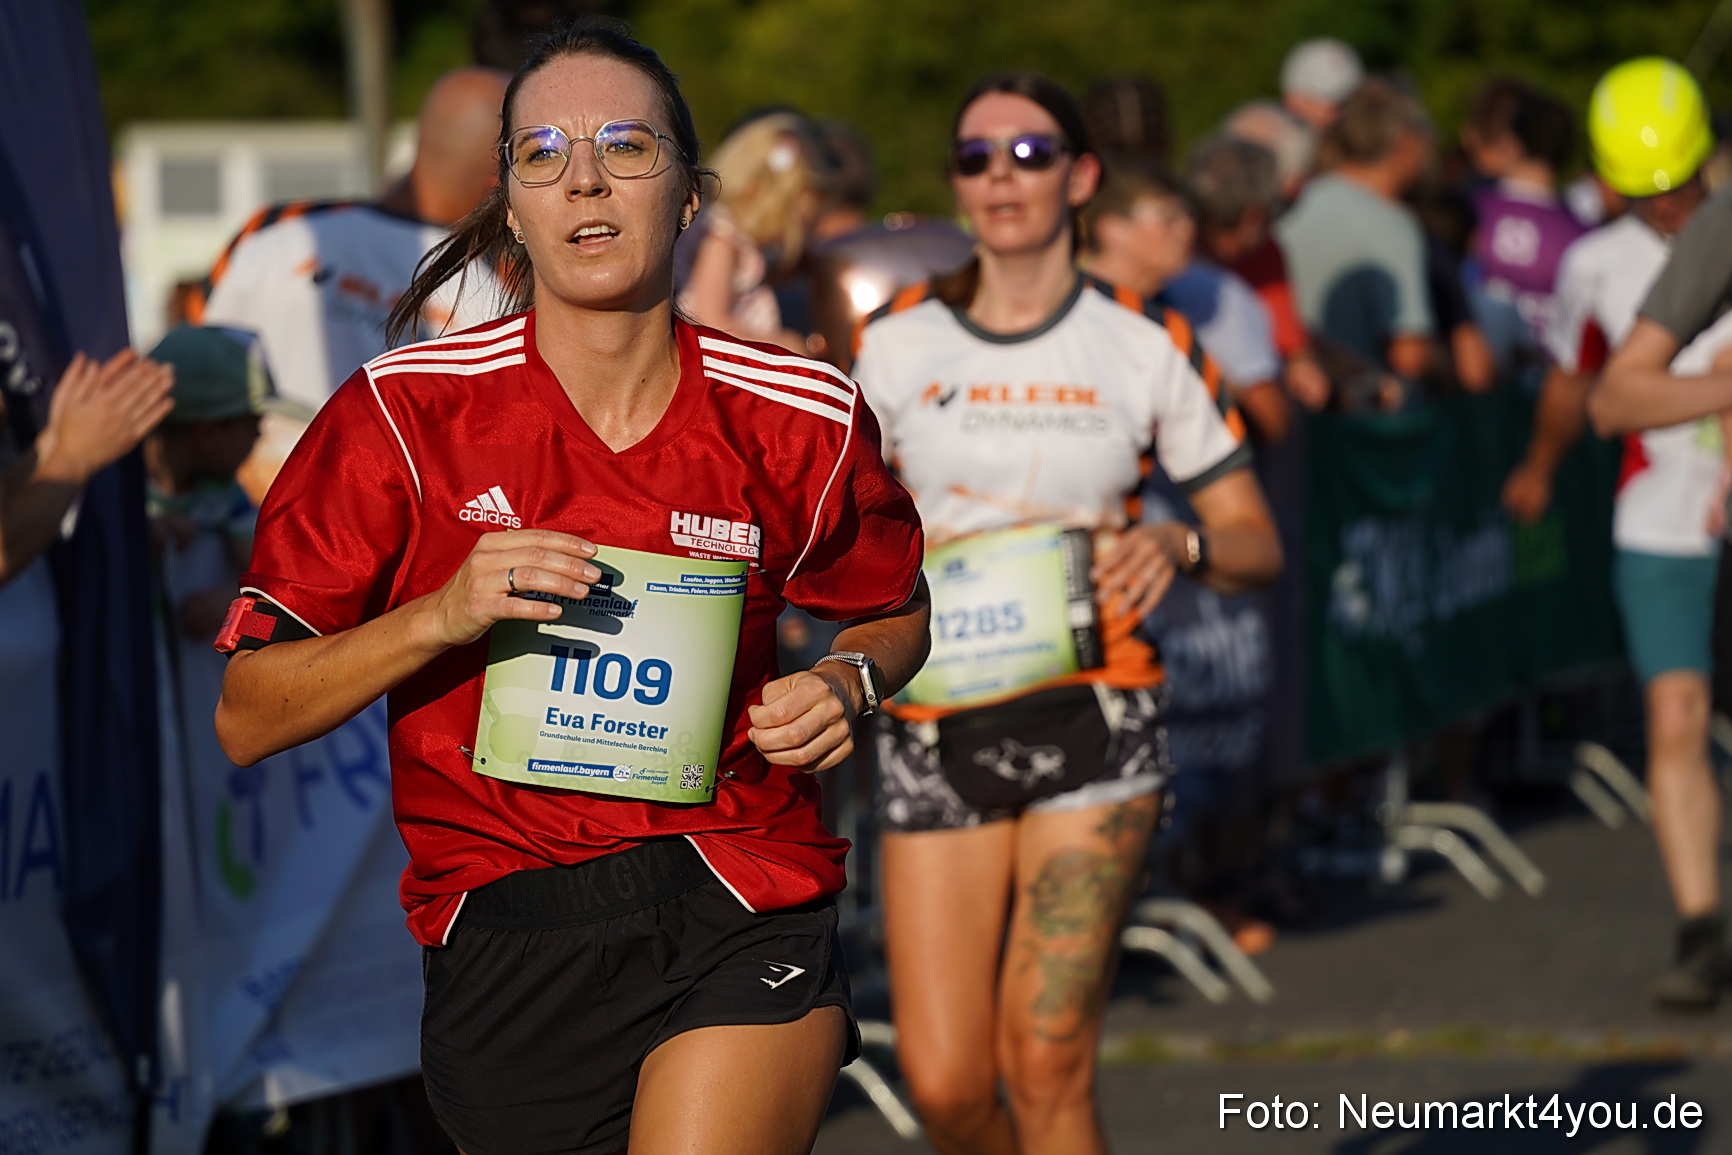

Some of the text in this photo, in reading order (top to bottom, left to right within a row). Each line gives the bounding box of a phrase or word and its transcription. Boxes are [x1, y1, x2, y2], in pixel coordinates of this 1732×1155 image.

[459, 508, 522, 529] adidas
[670, 511, 760, 547] HUBER
[689, 550, 711, 560] WASTE
[589, 609, 635, 619] neumarkt
[936, 601, 1026, 641] 1285
[550, 644, 673, 706] 1109
[546, 706, 669, 740] Eva Forster
[539, 730, 668, 755] Grundschule und Mittelschule Berching
[531, 762, 610, 777] firmenlauf.bayern
[632, 773, 669, 782] Firmenlauf
